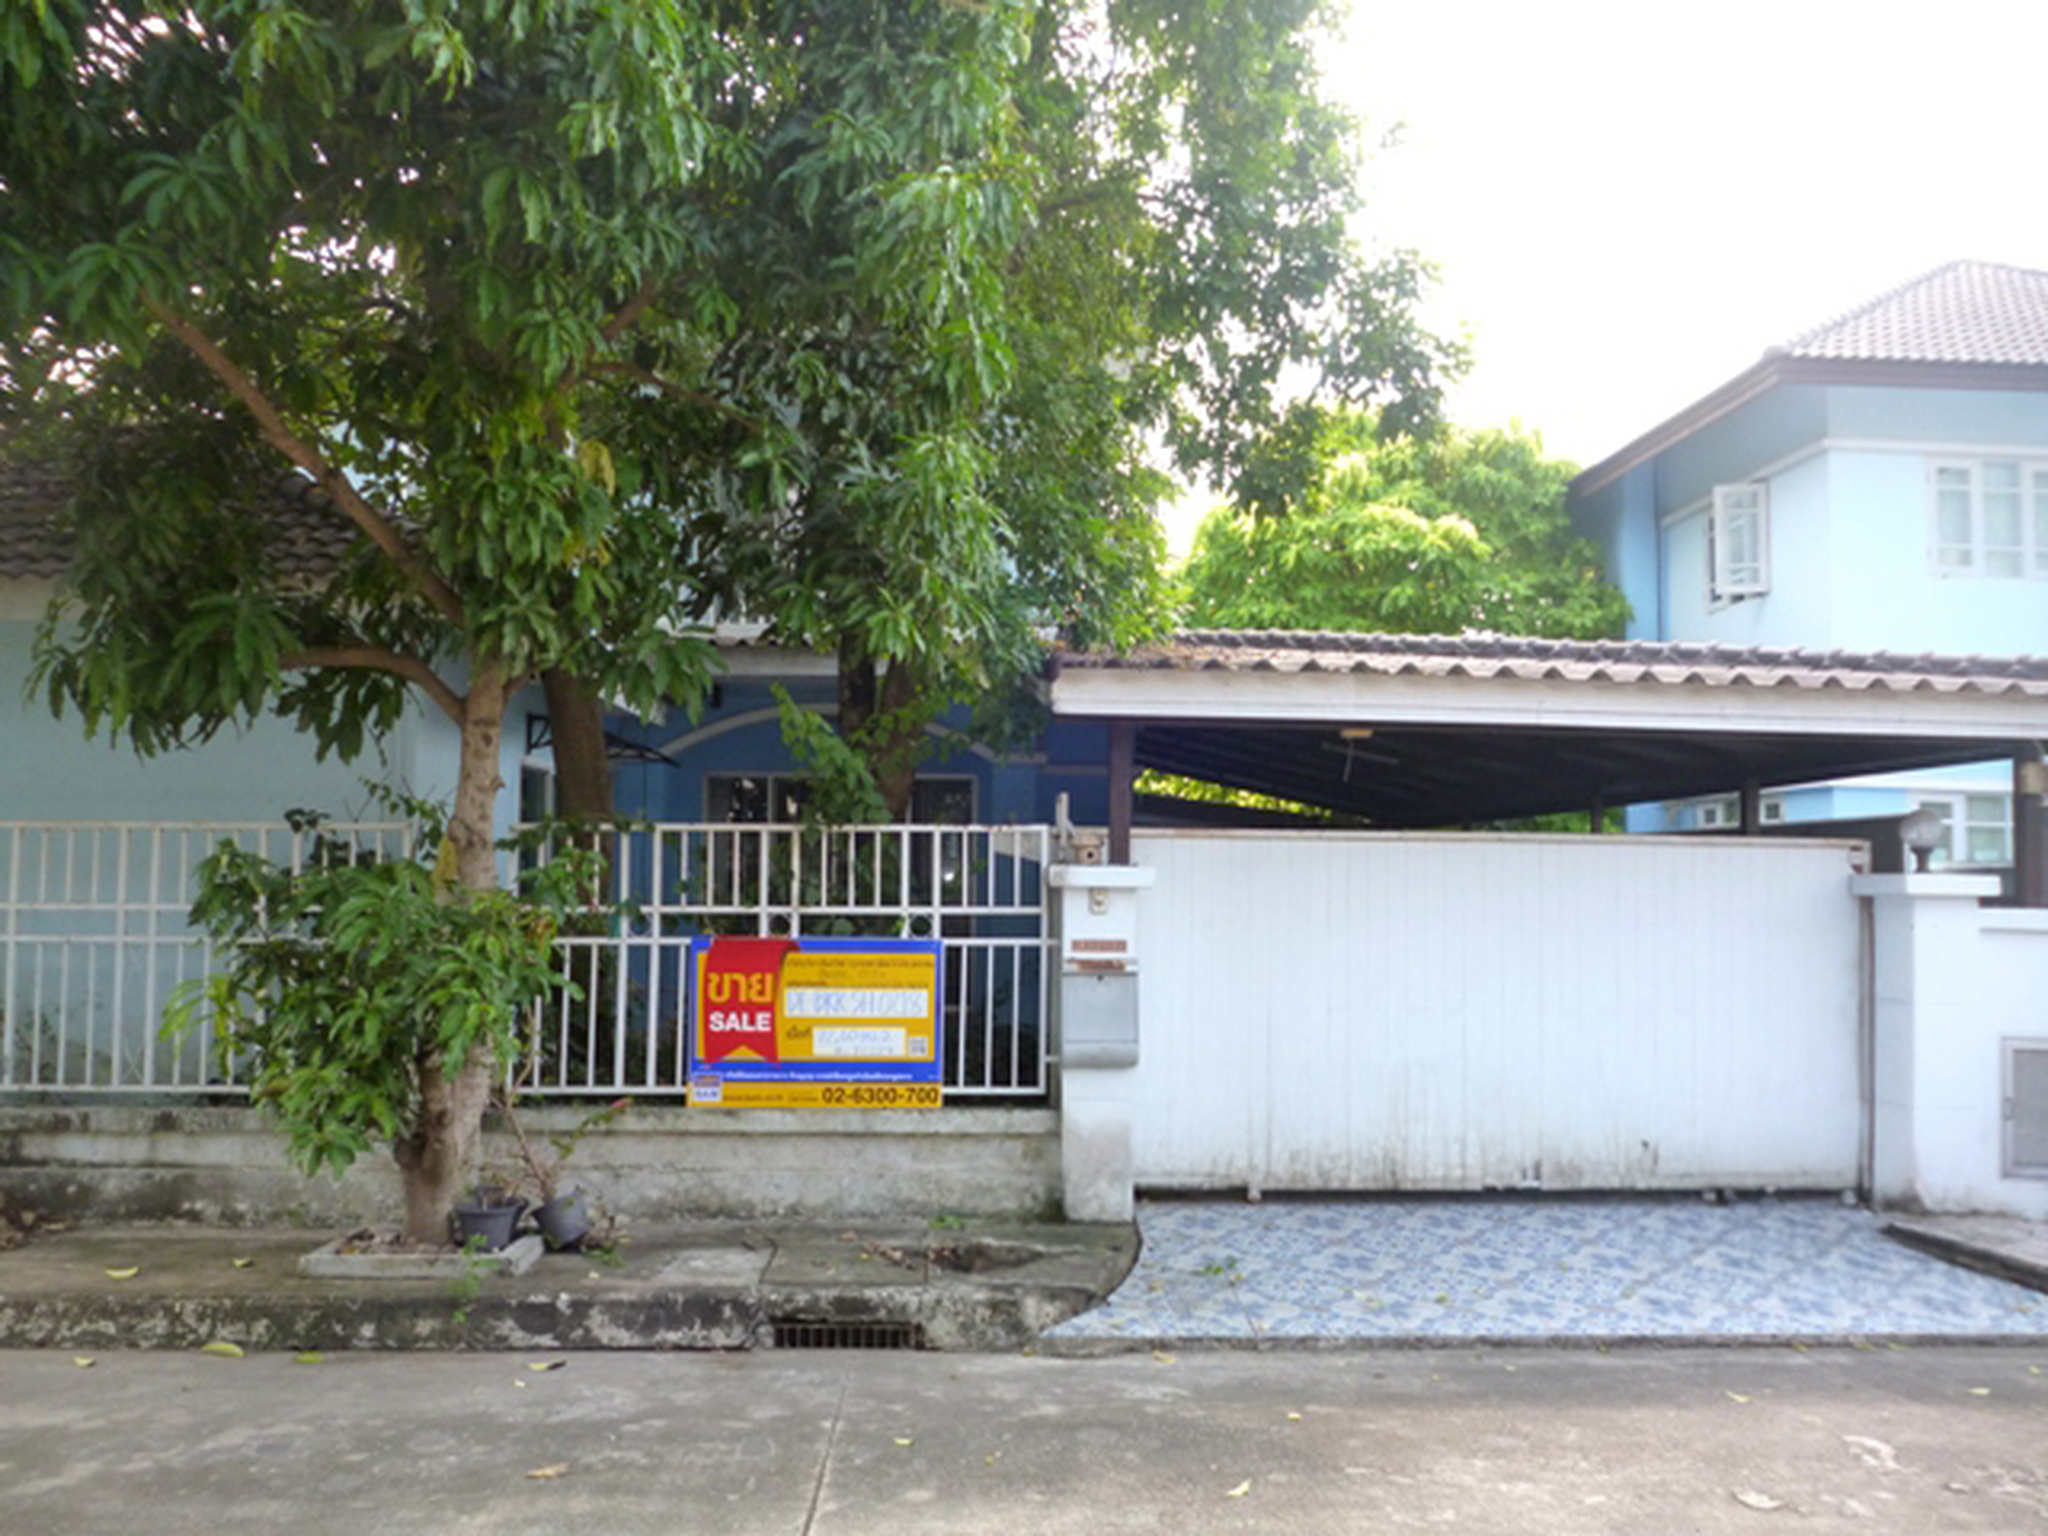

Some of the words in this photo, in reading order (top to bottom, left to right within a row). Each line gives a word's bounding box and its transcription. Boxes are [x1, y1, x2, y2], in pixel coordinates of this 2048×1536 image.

[707, 972, 774, 1004] ขาย
[709, 1011, 772, 1032] SALE
[822, 1088, 939, 1105] 02-6300-700
